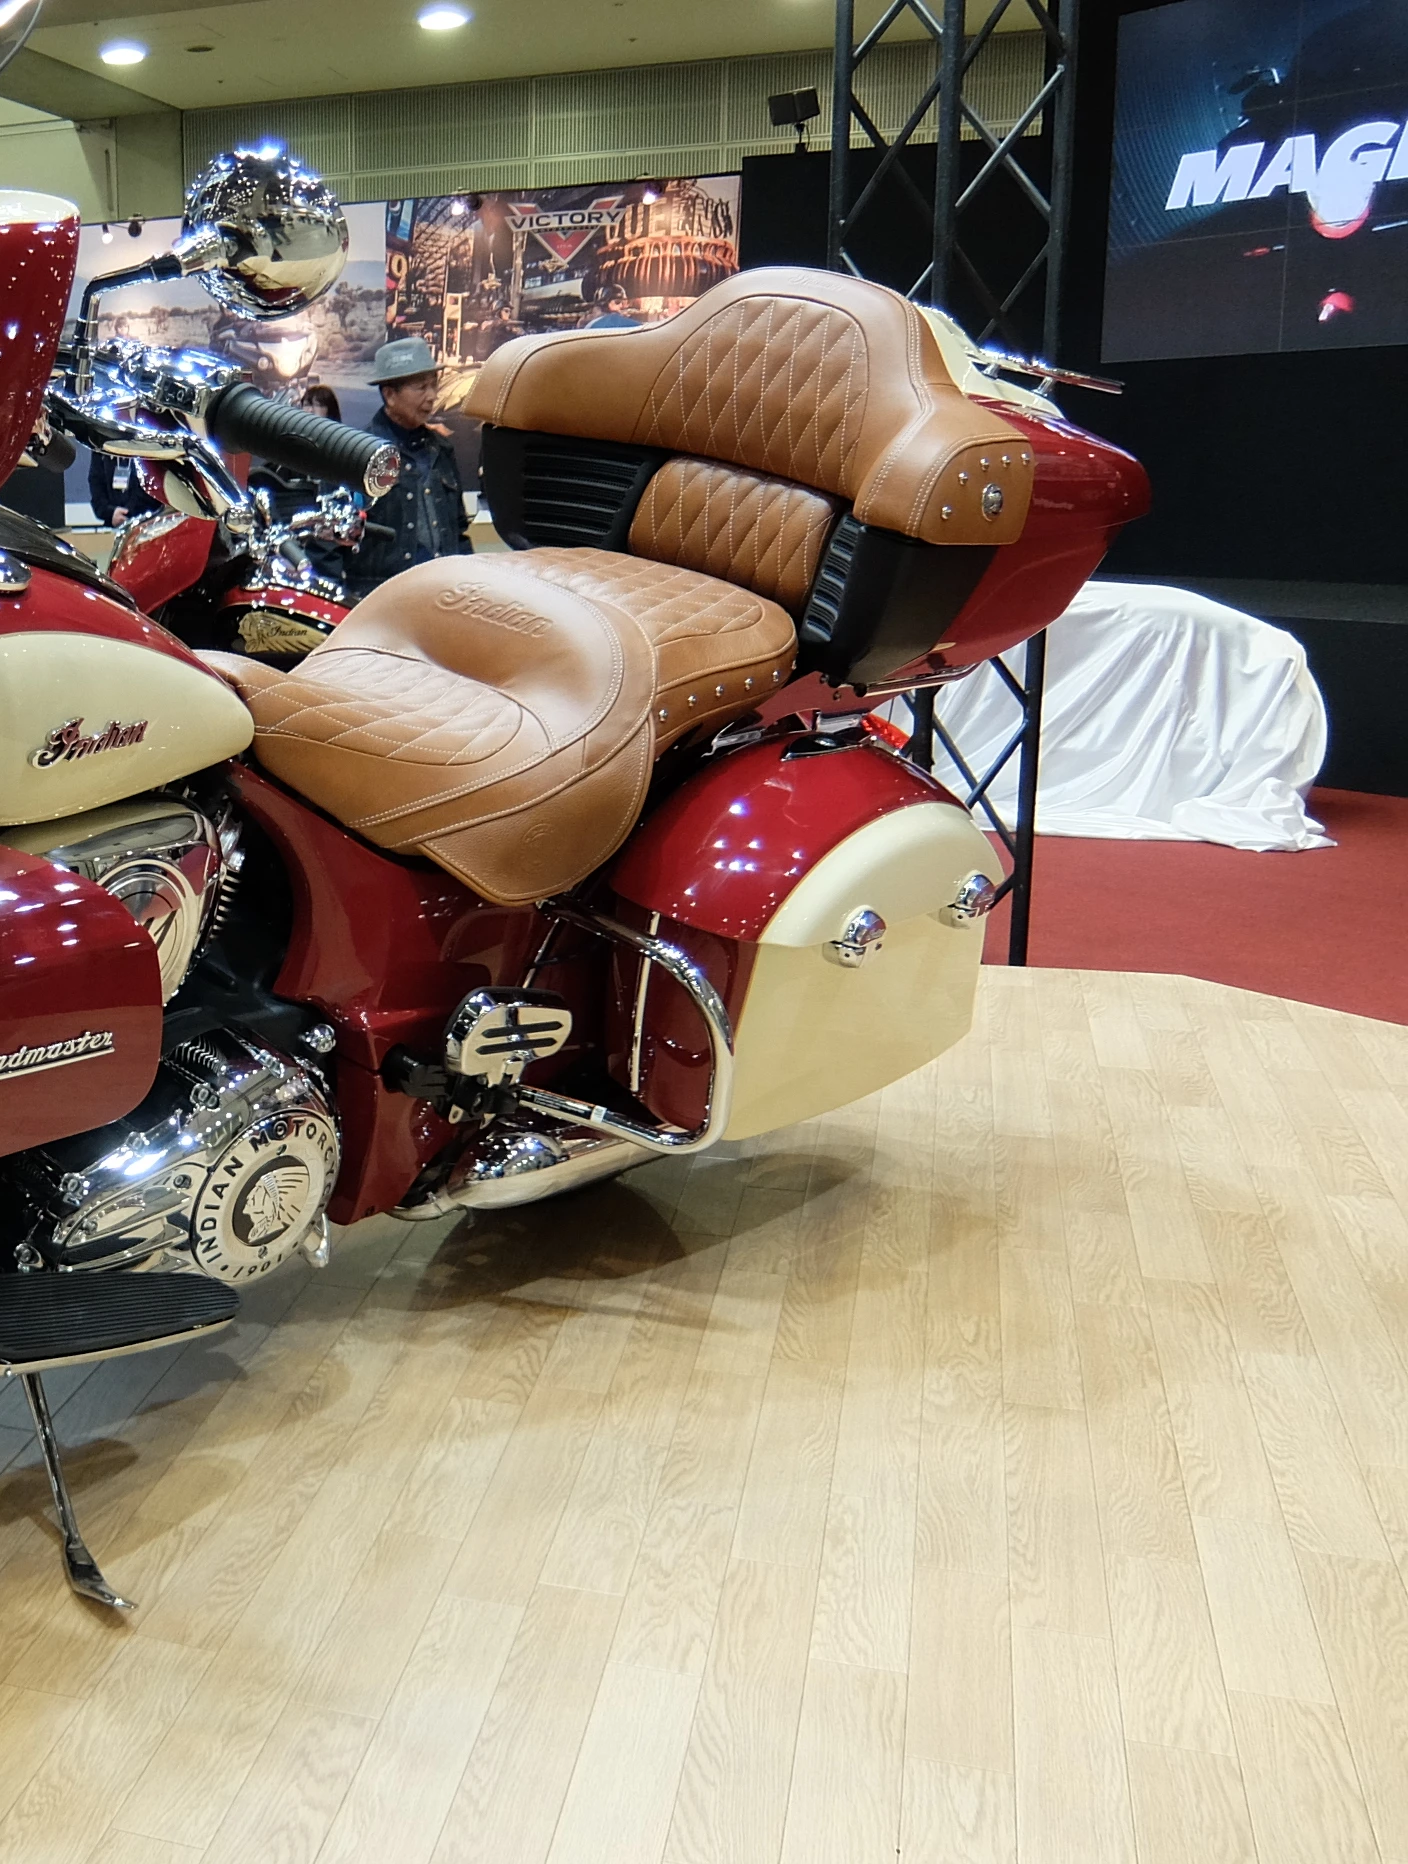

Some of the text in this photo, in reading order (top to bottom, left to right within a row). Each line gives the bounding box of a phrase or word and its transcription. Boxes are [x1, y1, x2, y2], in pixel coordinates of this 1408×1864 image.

[510, 211, 622, 229] VICTORY
[436, 581, 554, 638] Indian
[266, 625, 308, 637] Indian
[27, 716, 149, 770] Indian
[200, 1155, 245, 1264] INDIAN
[233, 1253, 283, 1279] 1901
